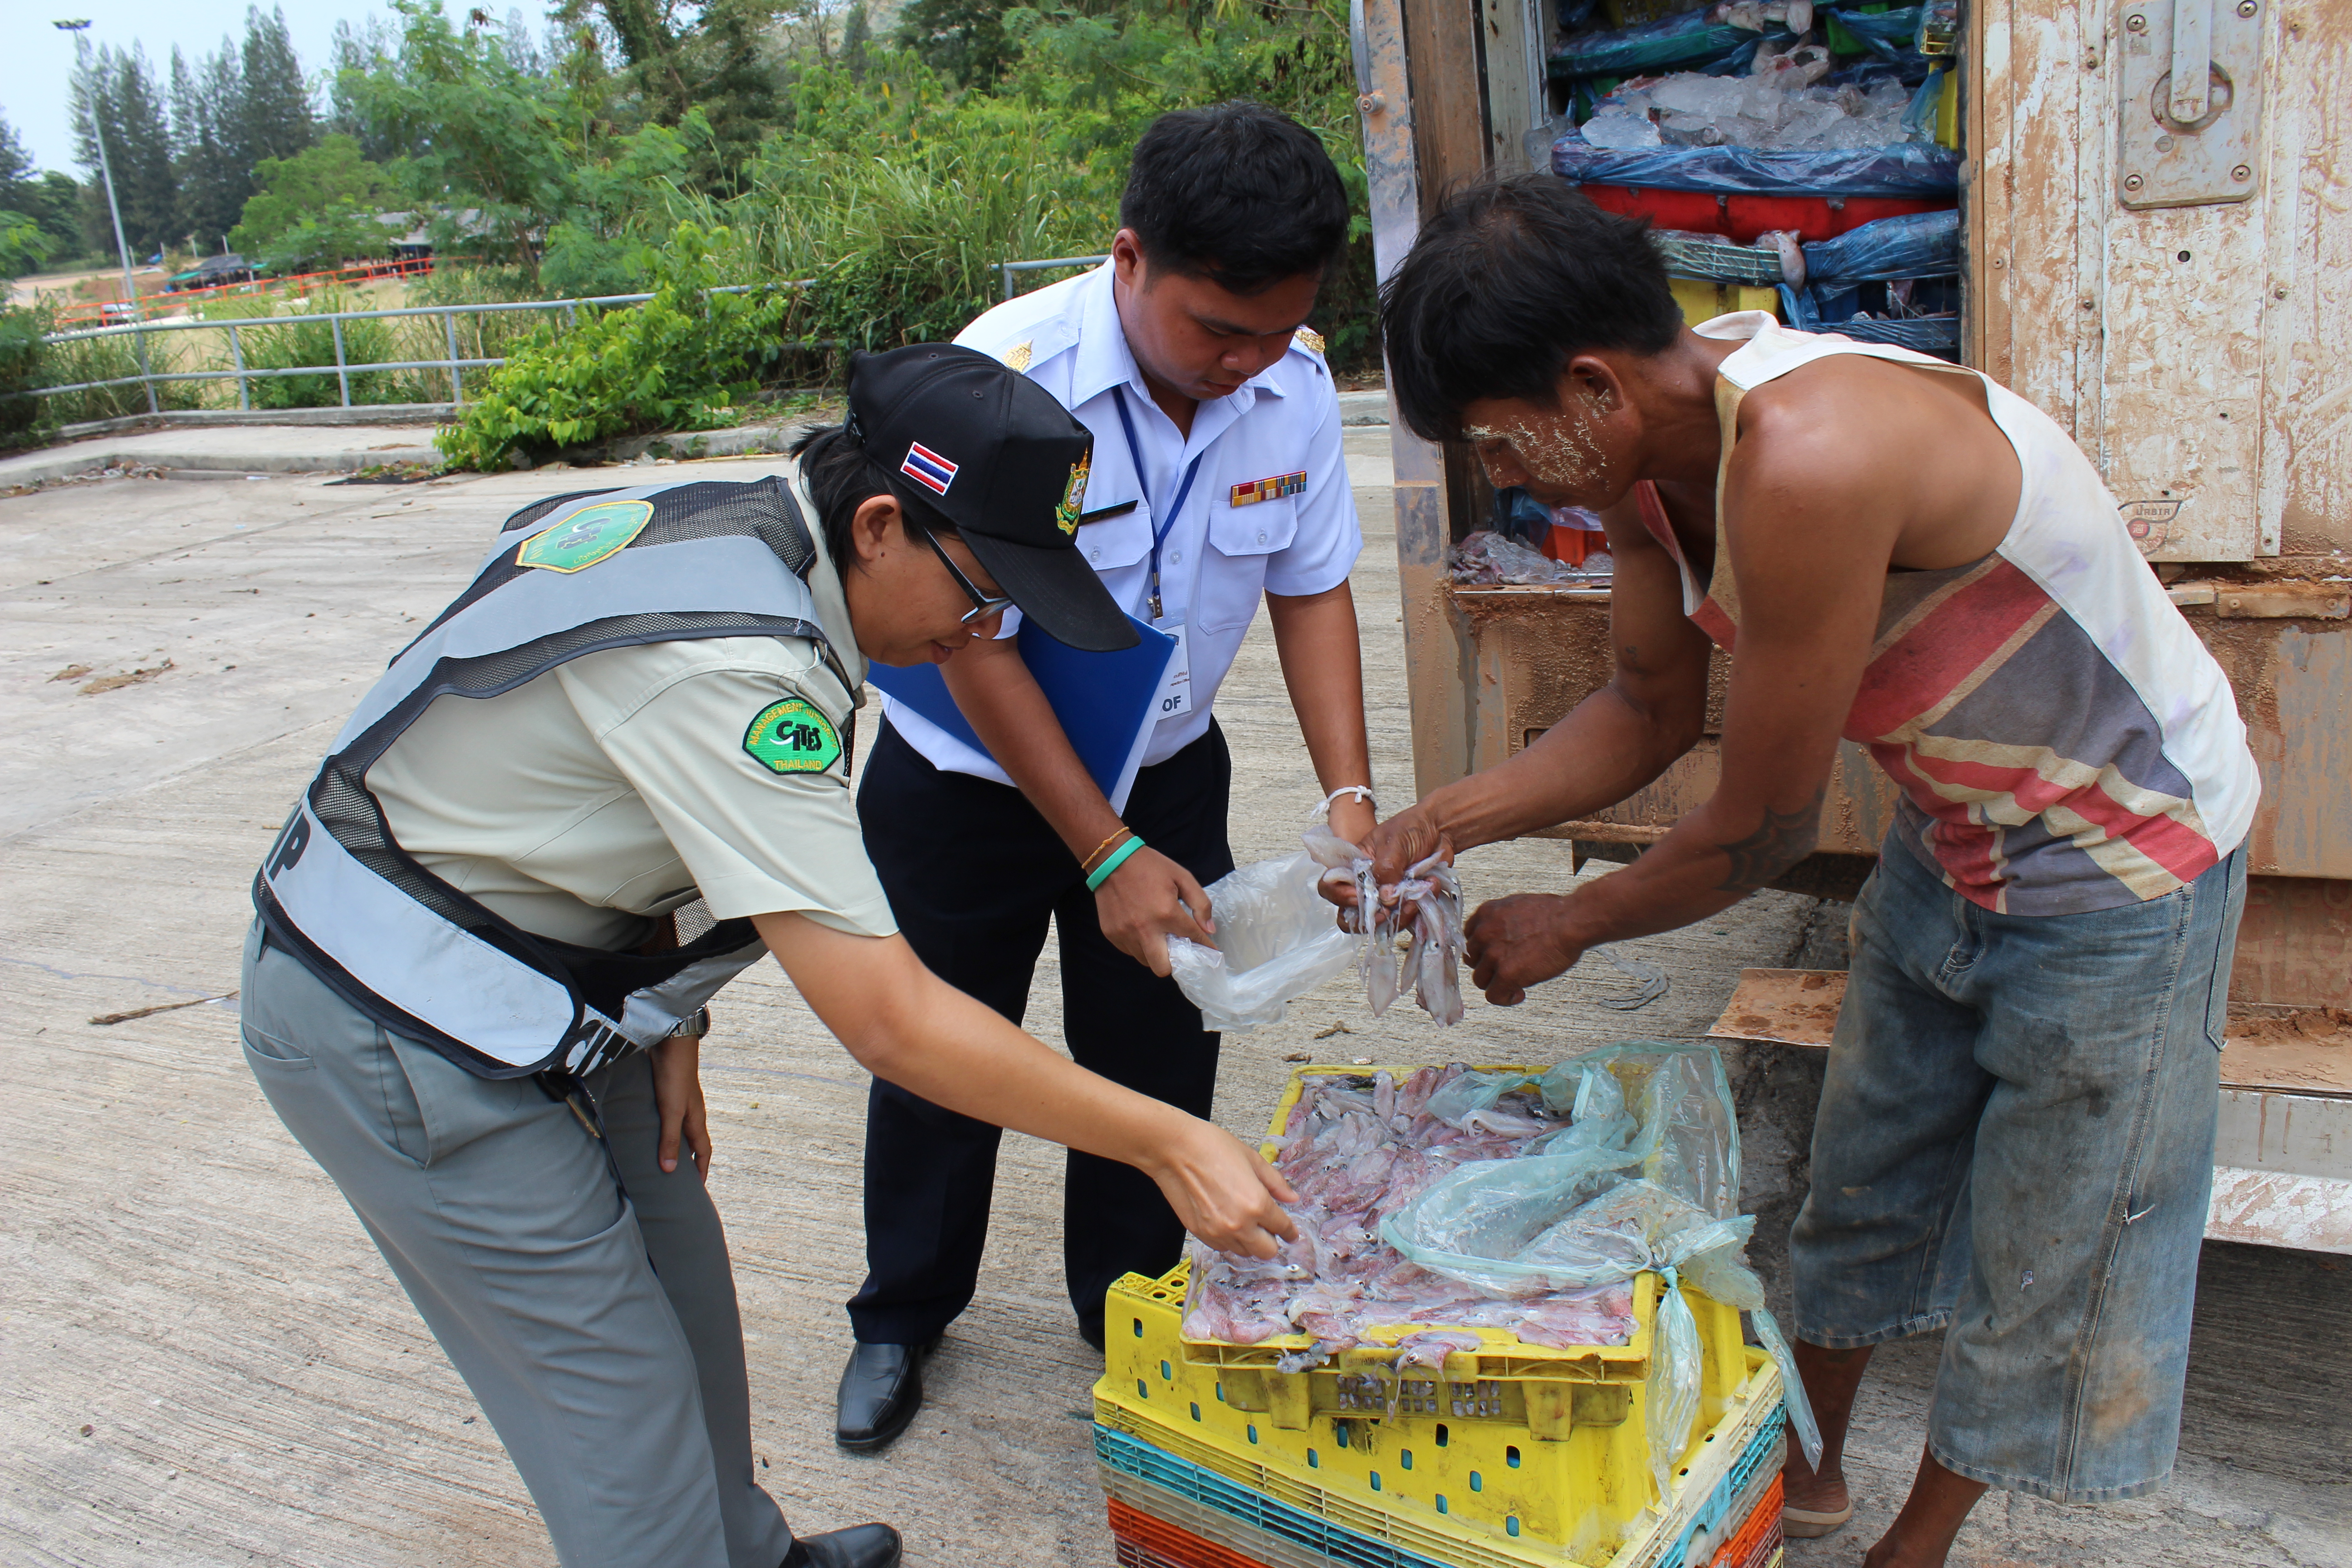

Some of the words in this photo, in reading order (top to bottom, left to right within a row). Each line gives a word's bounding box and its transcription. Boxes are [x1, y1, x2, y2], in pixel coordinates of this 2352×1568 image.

[1161, 695, 1181, 712] OF
[749, 702, 803, 745] MANAGEMENT
[805, 707, 837, 749] AUTHORITY
[774, 759, 823, 770] THAILAND
